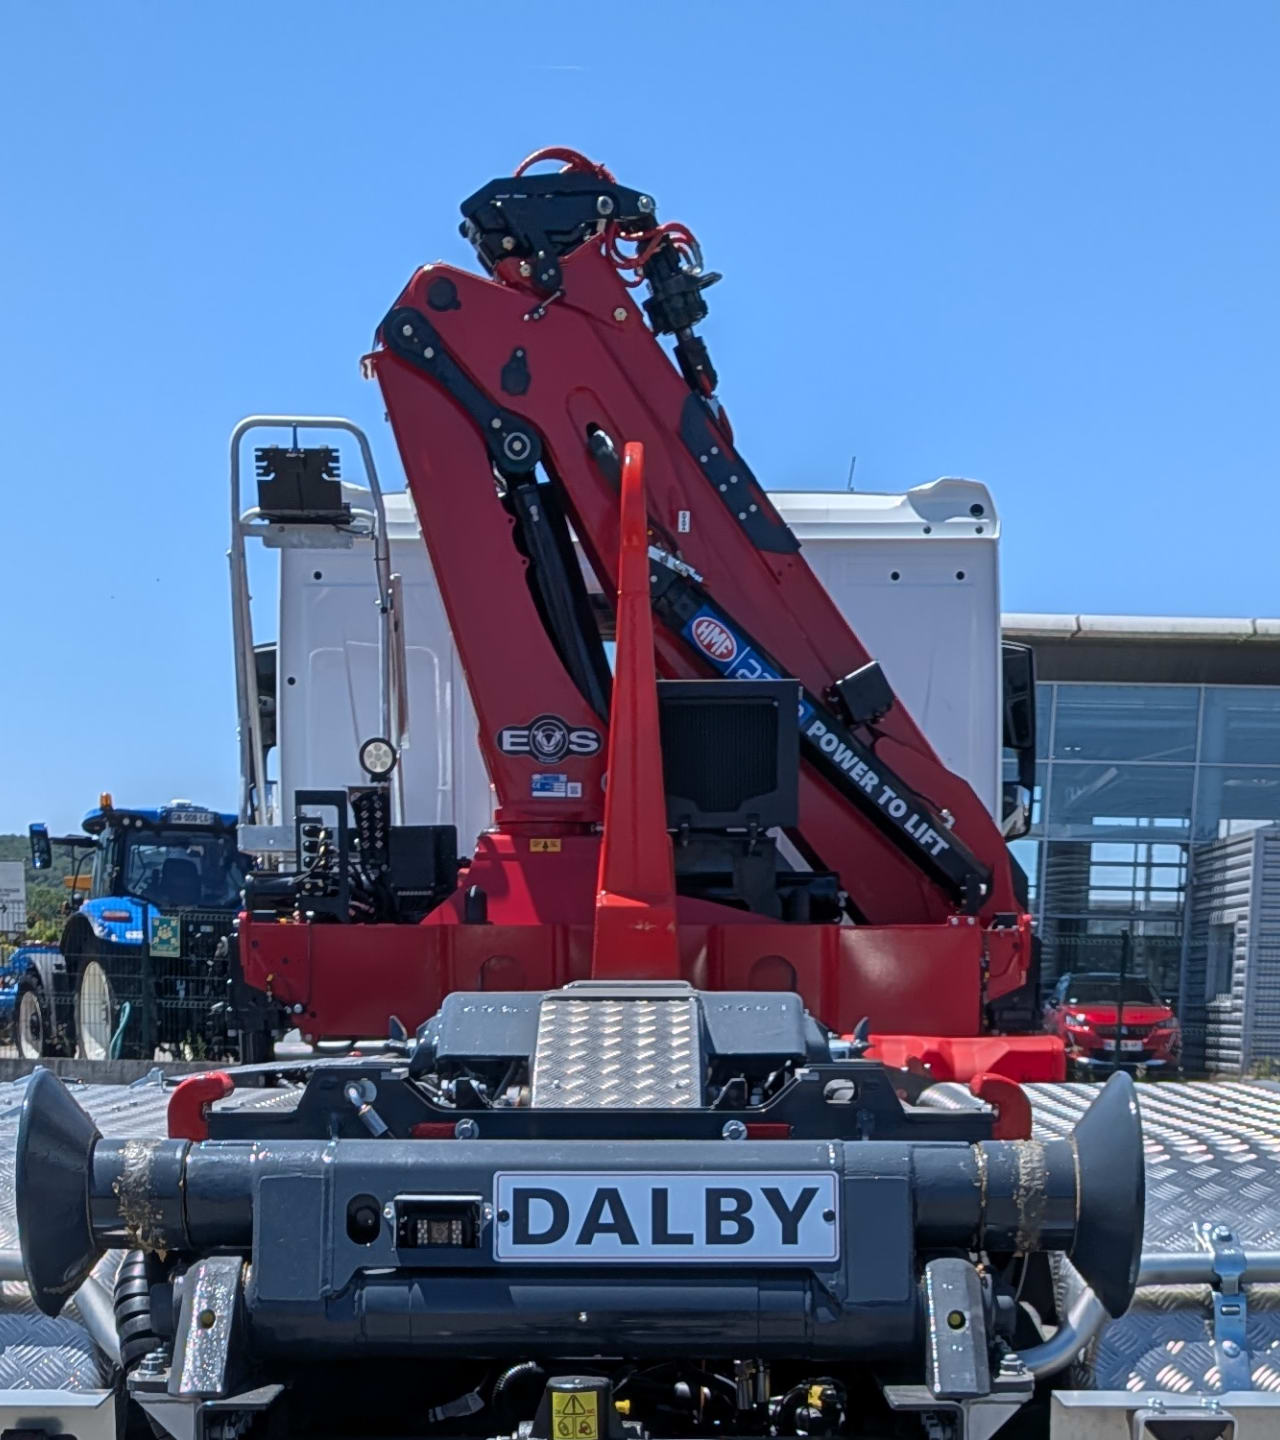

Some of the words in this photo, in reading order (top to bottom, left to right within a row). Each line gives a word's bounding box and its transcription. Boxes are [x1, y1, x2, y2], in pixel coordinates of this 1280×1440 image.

[697, 620, 733, 657] HMF
[806, 719, 880, 794] POWER
[877, 785, 908, 819] TO
[903, 812, 950, 857] LIFT
[511, 1186, 820, 1246] DALBY
